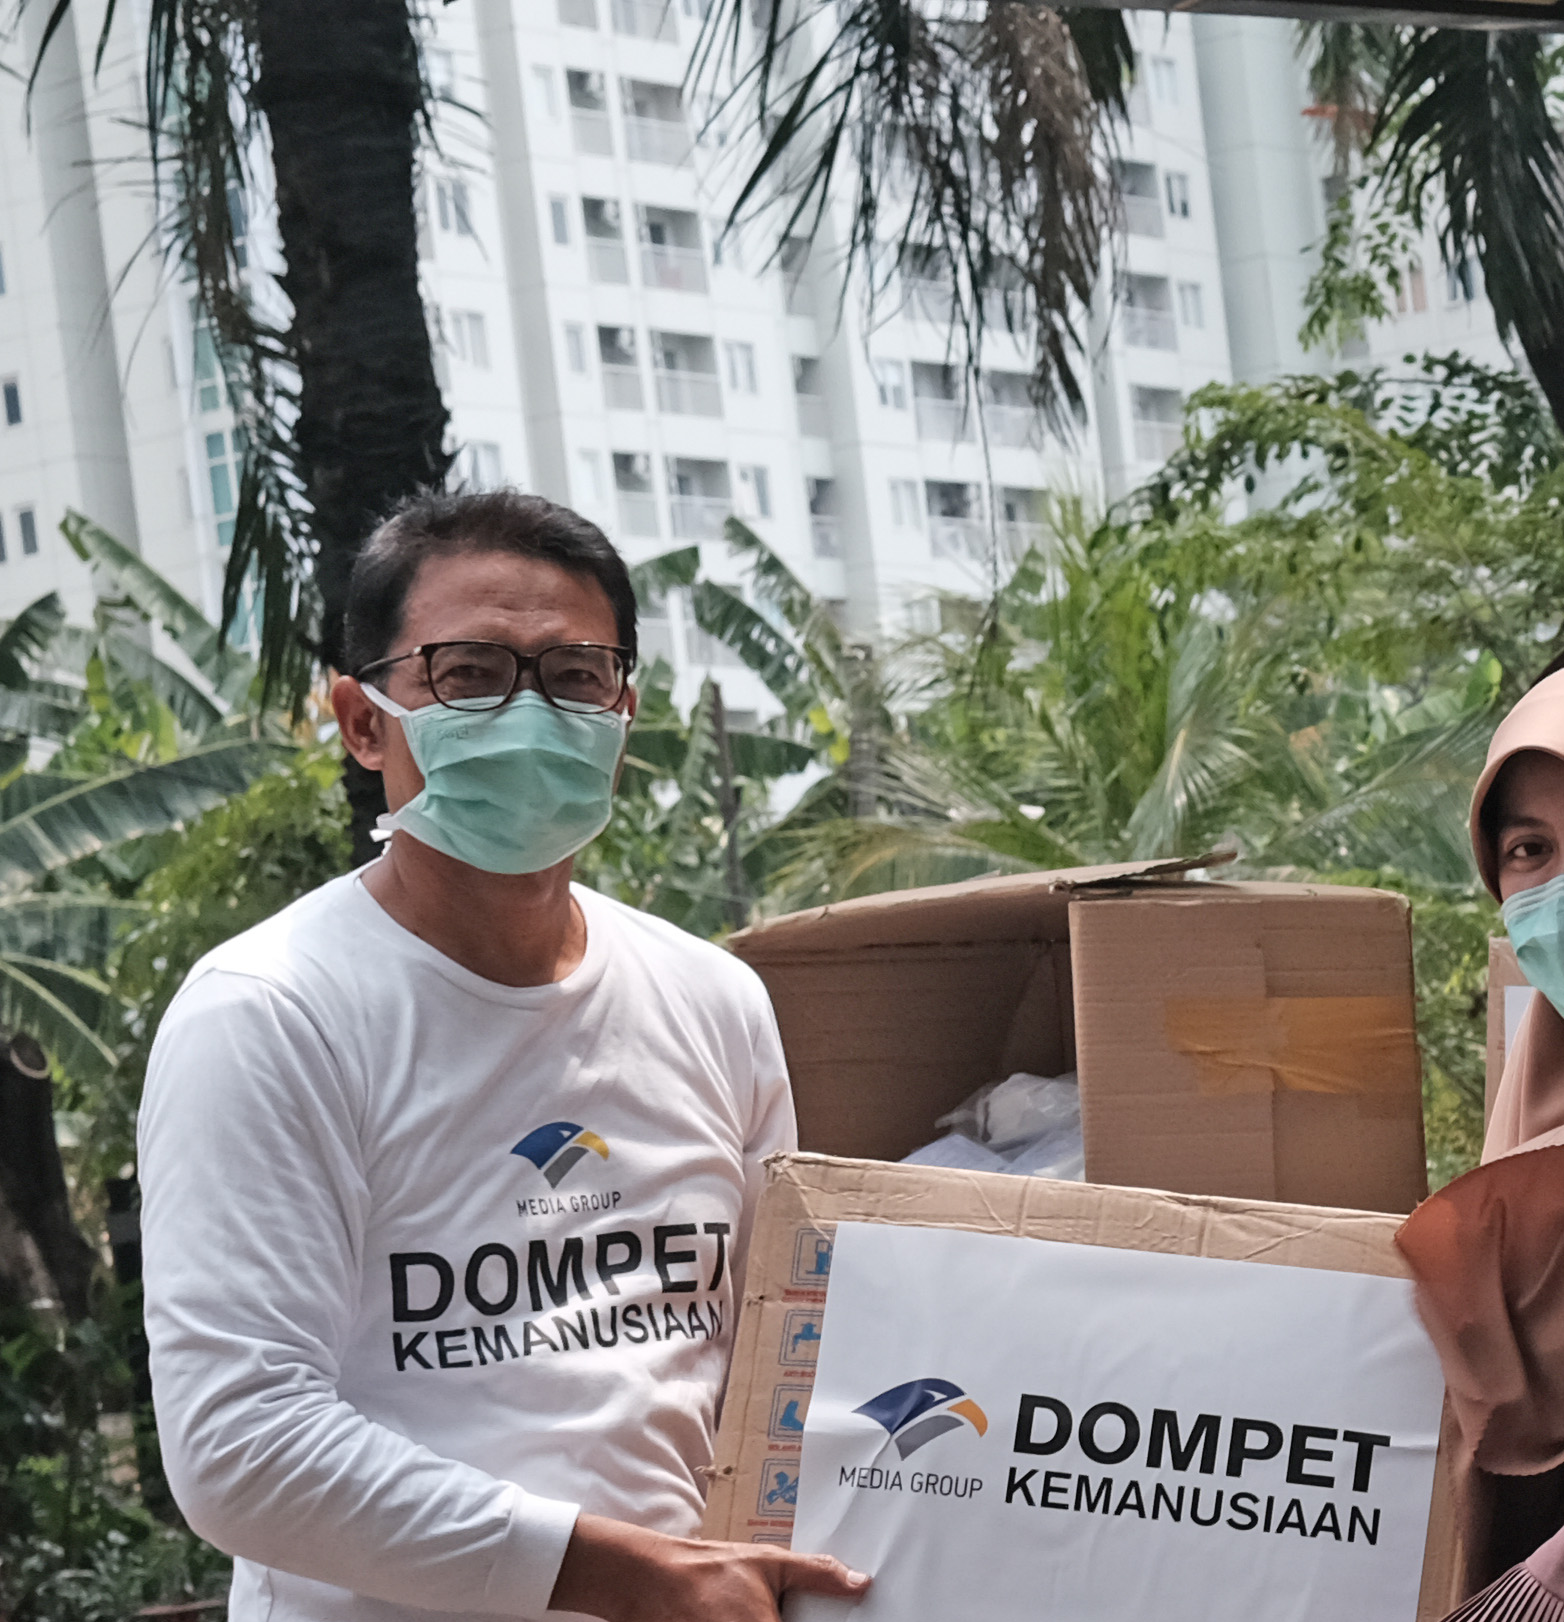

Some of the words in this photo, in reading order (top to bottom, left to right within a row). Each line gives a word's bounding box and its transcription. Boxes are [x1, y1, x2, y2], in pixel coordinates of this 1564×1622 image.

[516, 1197, 567, 1217] MEDIA
[569, 1191, 622, 1213] GROUP
[389, 1222, 731, 1322] DOMPET
[392, 1300, 724, 1372] KEMANUSIAAN
[1013, 1393, 1391, 1493] DOMPET
[839, 1465, 903, 1491] MEDIA
[910, 1471, 983, 1499] GROUP
[1004, 1466, 1381, 1546] KEMANUSIAAN
